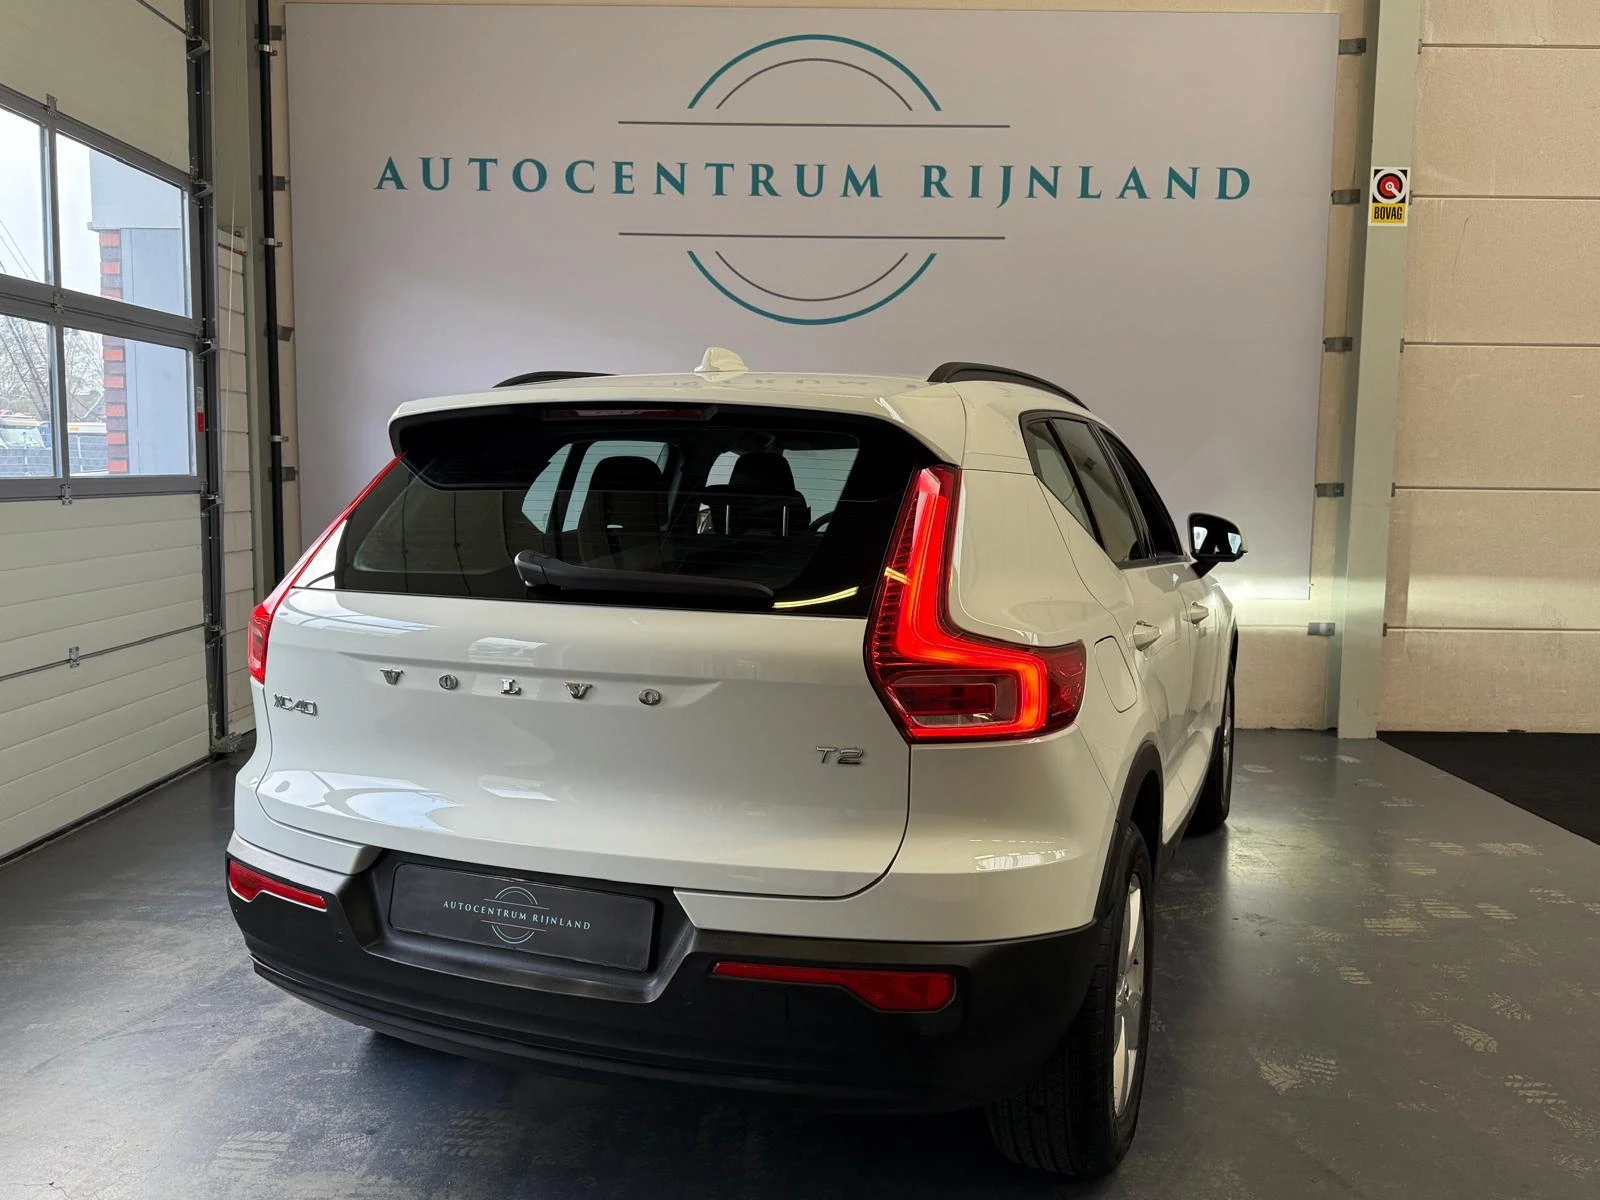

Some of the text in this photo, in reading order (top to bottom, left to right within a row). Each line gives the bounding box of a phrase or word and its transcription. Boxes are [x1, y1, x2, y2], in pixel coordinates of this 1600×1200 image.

[374, 156, 1251, 208] AUTOCENTRUM RIJNLAND
[1374, 206, 1403, 221] BOVAG
[380, 667, 662, 706] VOLVO
[273, 693, 318, 716] XC40
[816, 746, 864, 765] T2
[442, 900, 591, 930] AUTOCENTRUM RIJNLAND
